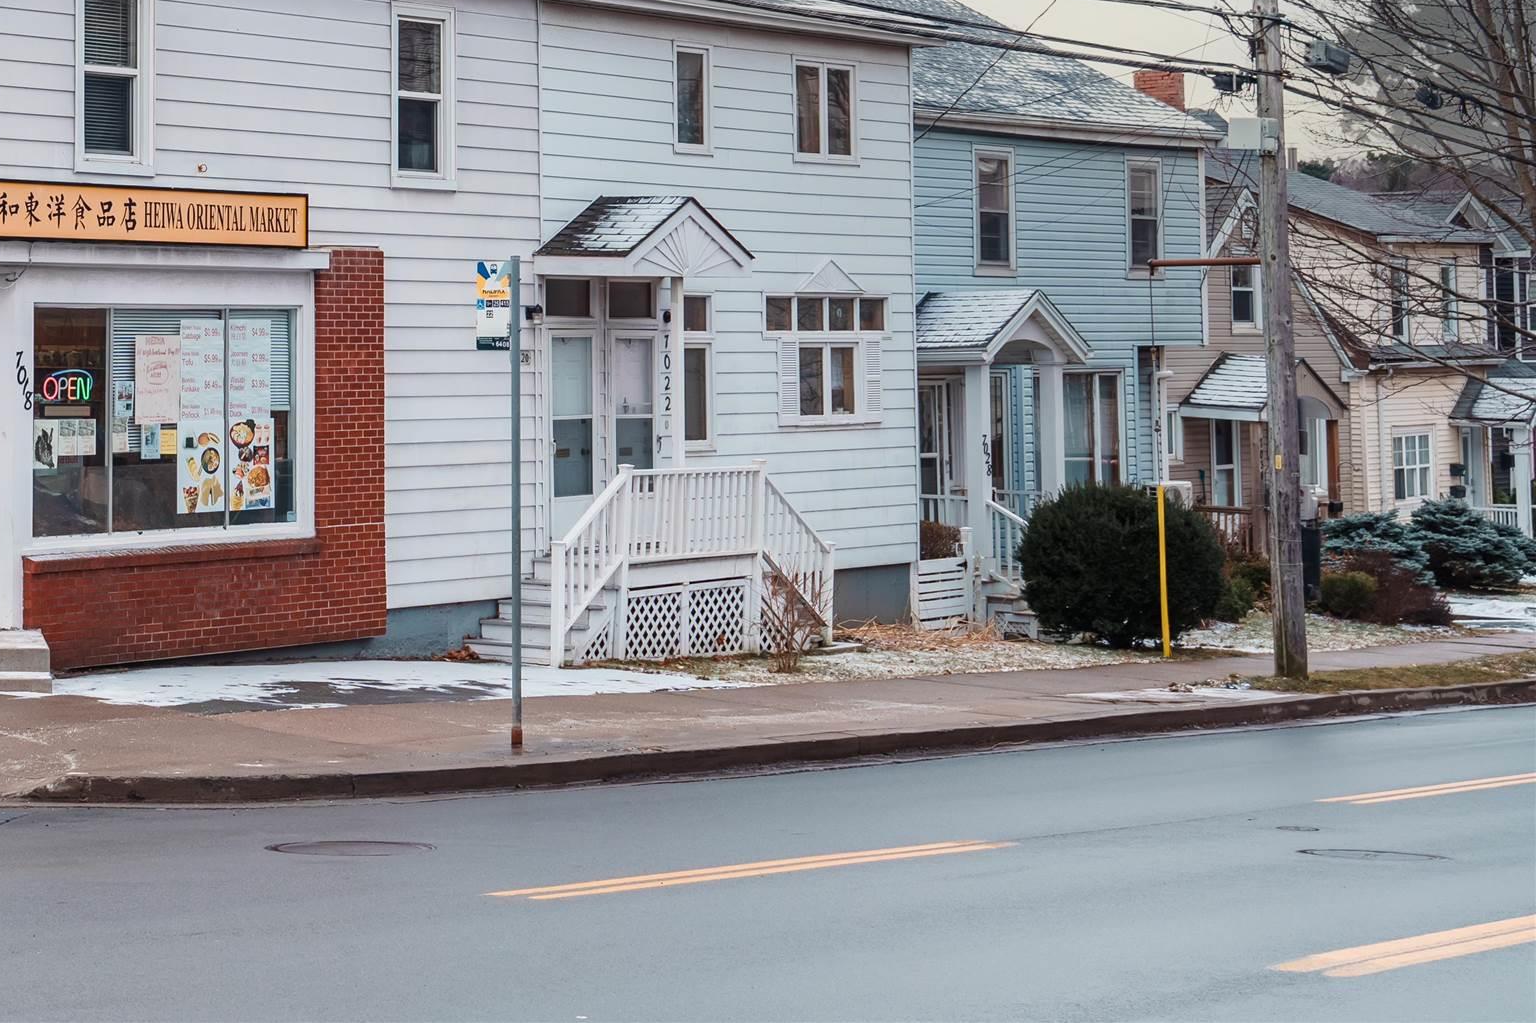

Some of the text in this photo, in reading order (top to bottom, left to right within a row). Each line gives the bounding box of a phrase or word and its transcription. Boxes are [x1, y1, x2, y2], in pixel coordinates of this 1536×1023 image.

[144, 200, 184, 230] HEIWA
[187, 202, 247, 233] ORIENTAL
[249, 206, 298, 235] MARKET
[15, 350, 34, 411] 7018
[43, 376, 90, 401] OPEN
[663, 334, 671, 411] 7022
[981, 434, 993, 477] 7028
